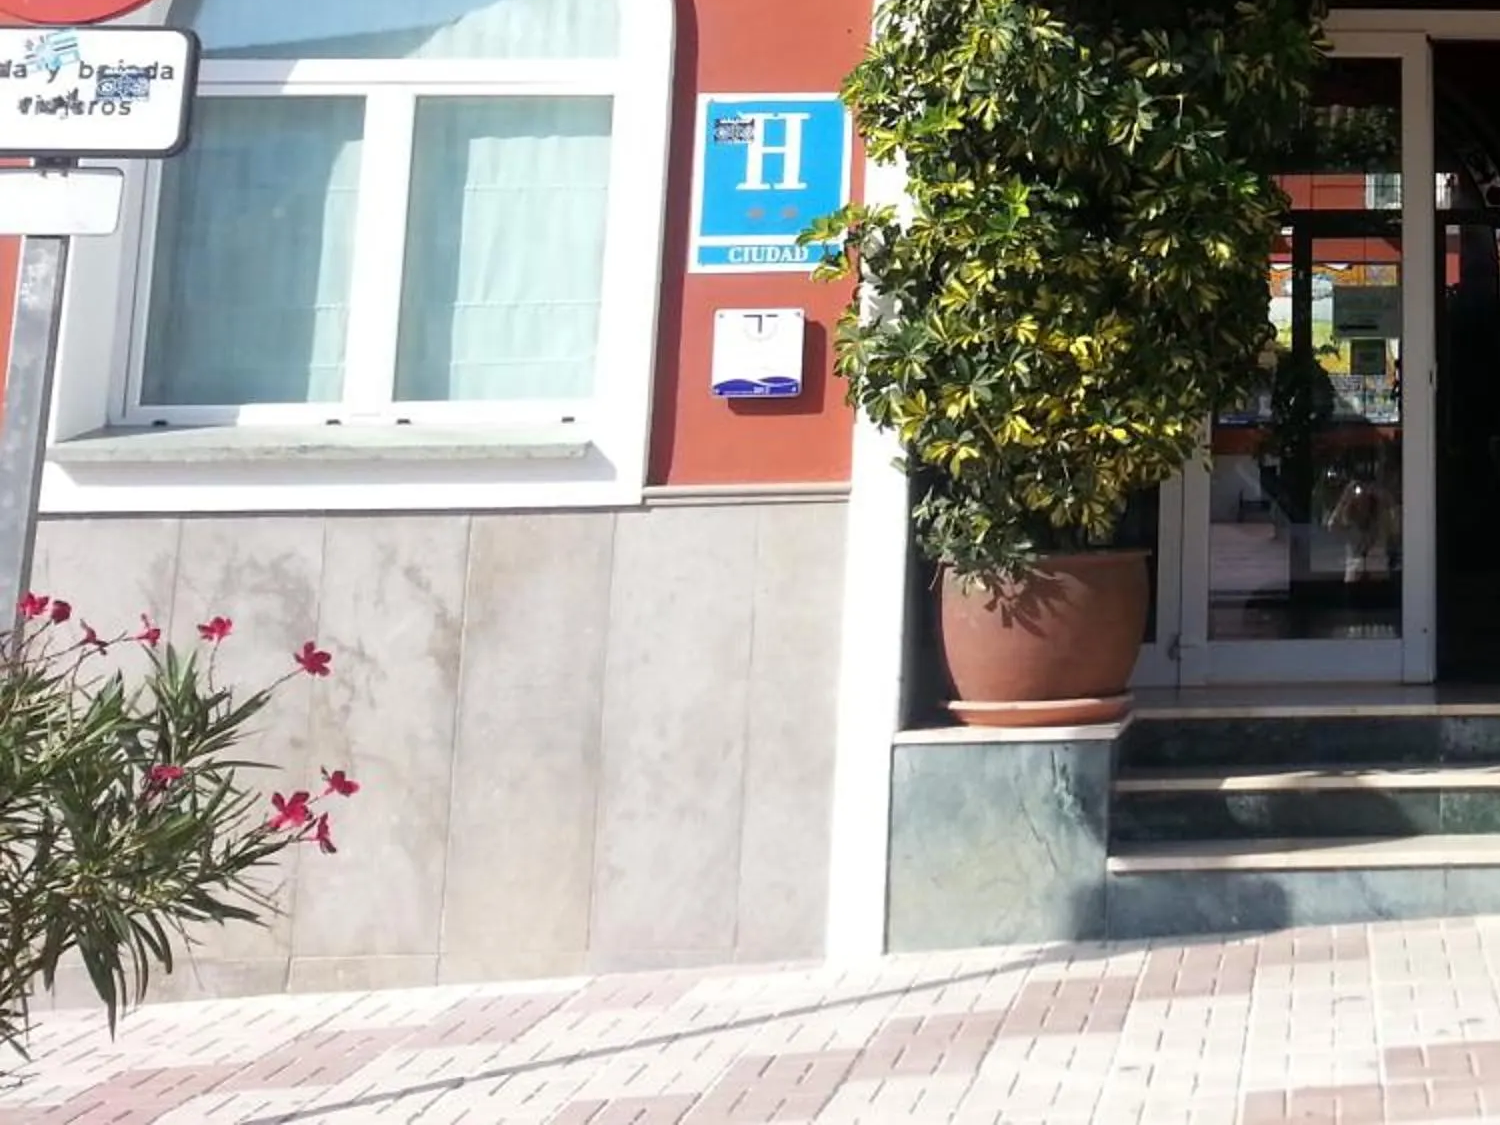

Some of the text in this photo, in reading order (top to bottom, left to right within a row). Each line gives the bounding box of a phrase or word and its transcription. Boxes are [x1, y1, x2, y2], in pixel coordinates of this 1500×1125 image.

[45, 62, 61, 84] y
[735, 112, 812, 191] H
[728, 245, 810, 263] CIUDAD
